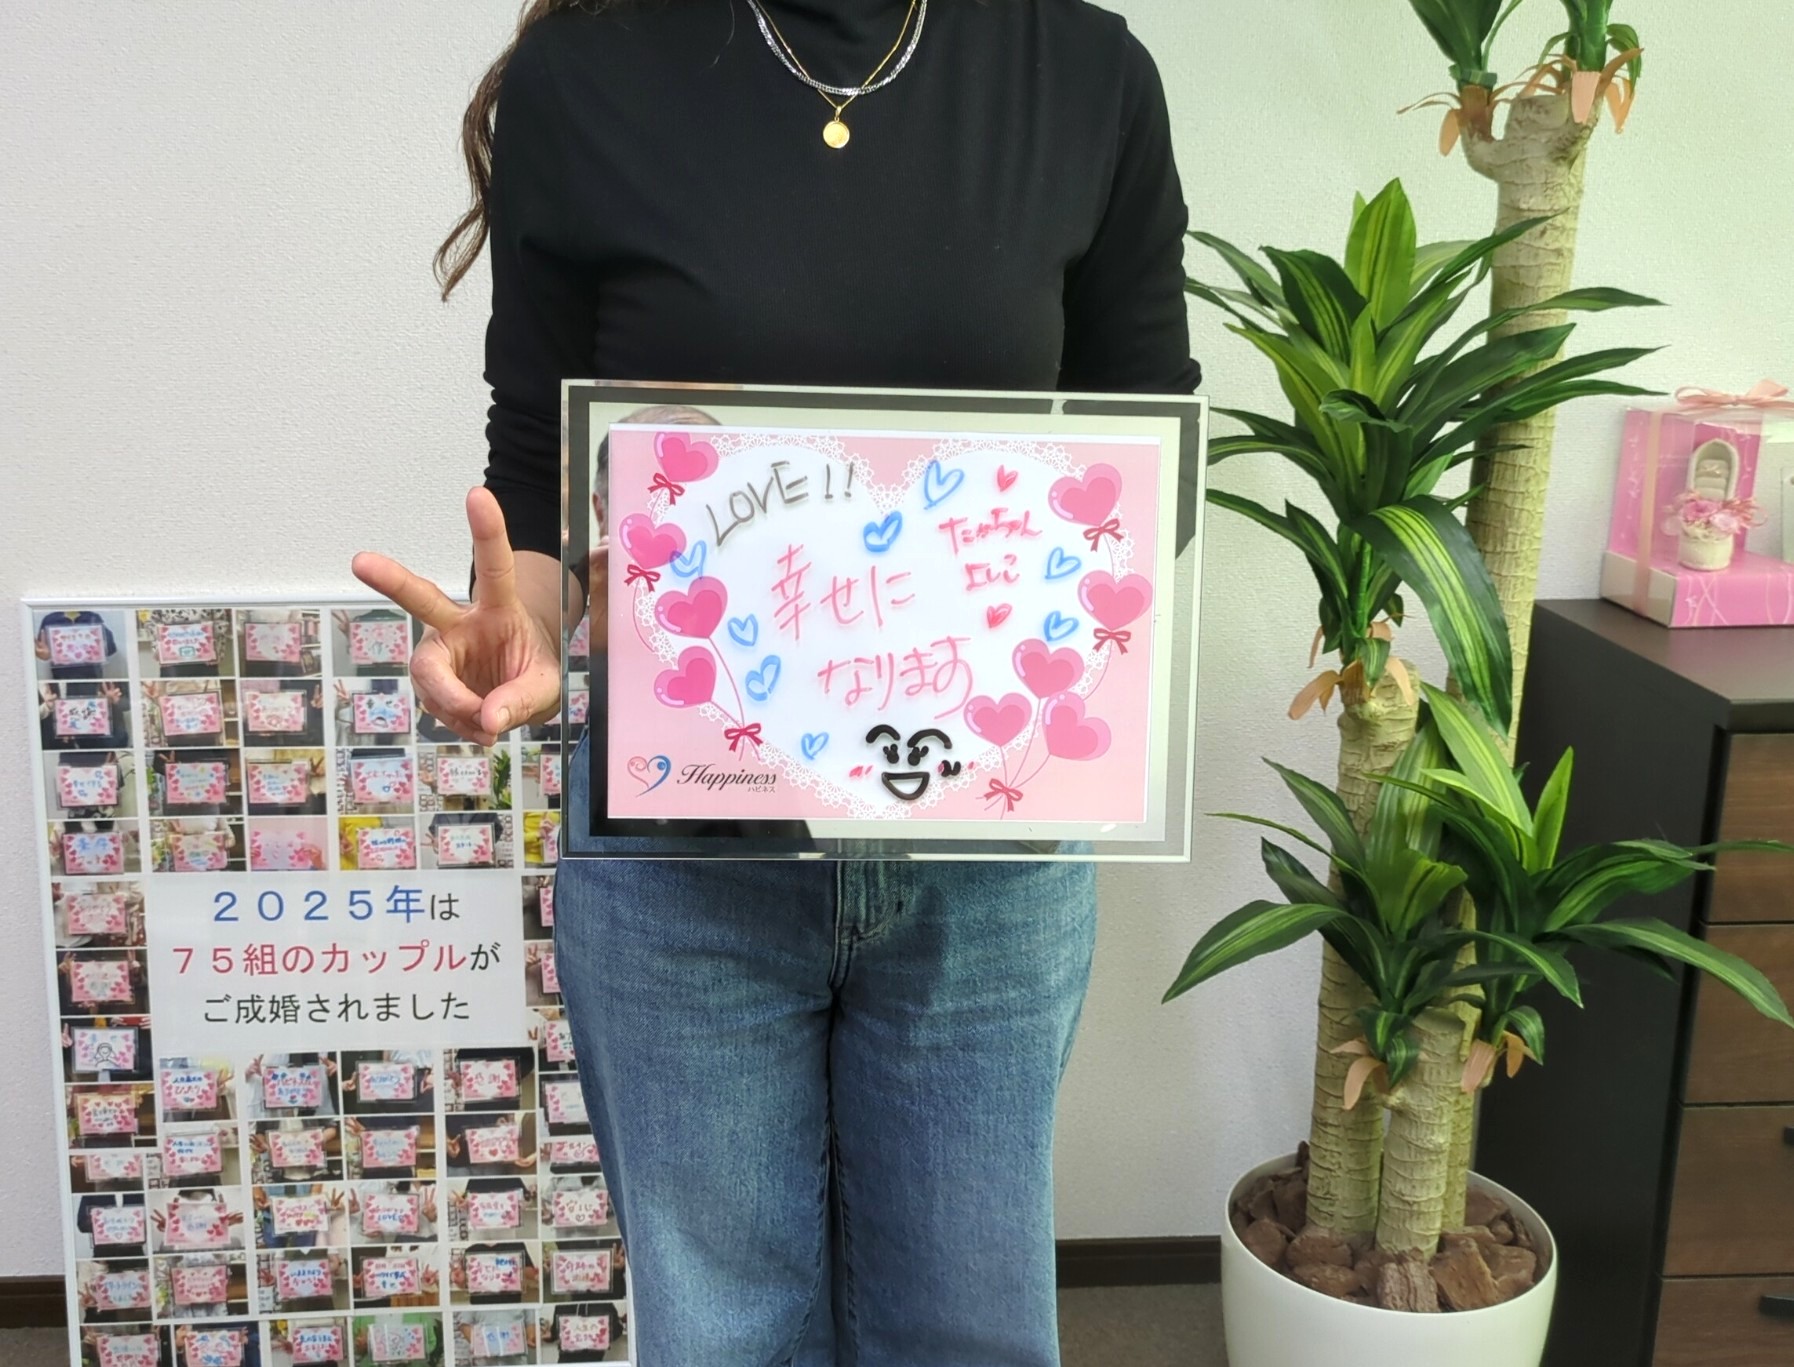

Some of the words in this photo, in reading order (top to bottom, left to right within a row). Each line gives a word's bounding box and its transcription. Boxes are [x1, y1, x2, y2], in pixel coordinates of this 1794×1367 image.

[771, 543, 916, 641] 幸せに
[816, 634, 975, 721] なります
[676, 763, 777, 791] Happiness
[747, 785, 776, 793] ハピネス
[203, 992, 471, 1025] ご成婚されました
